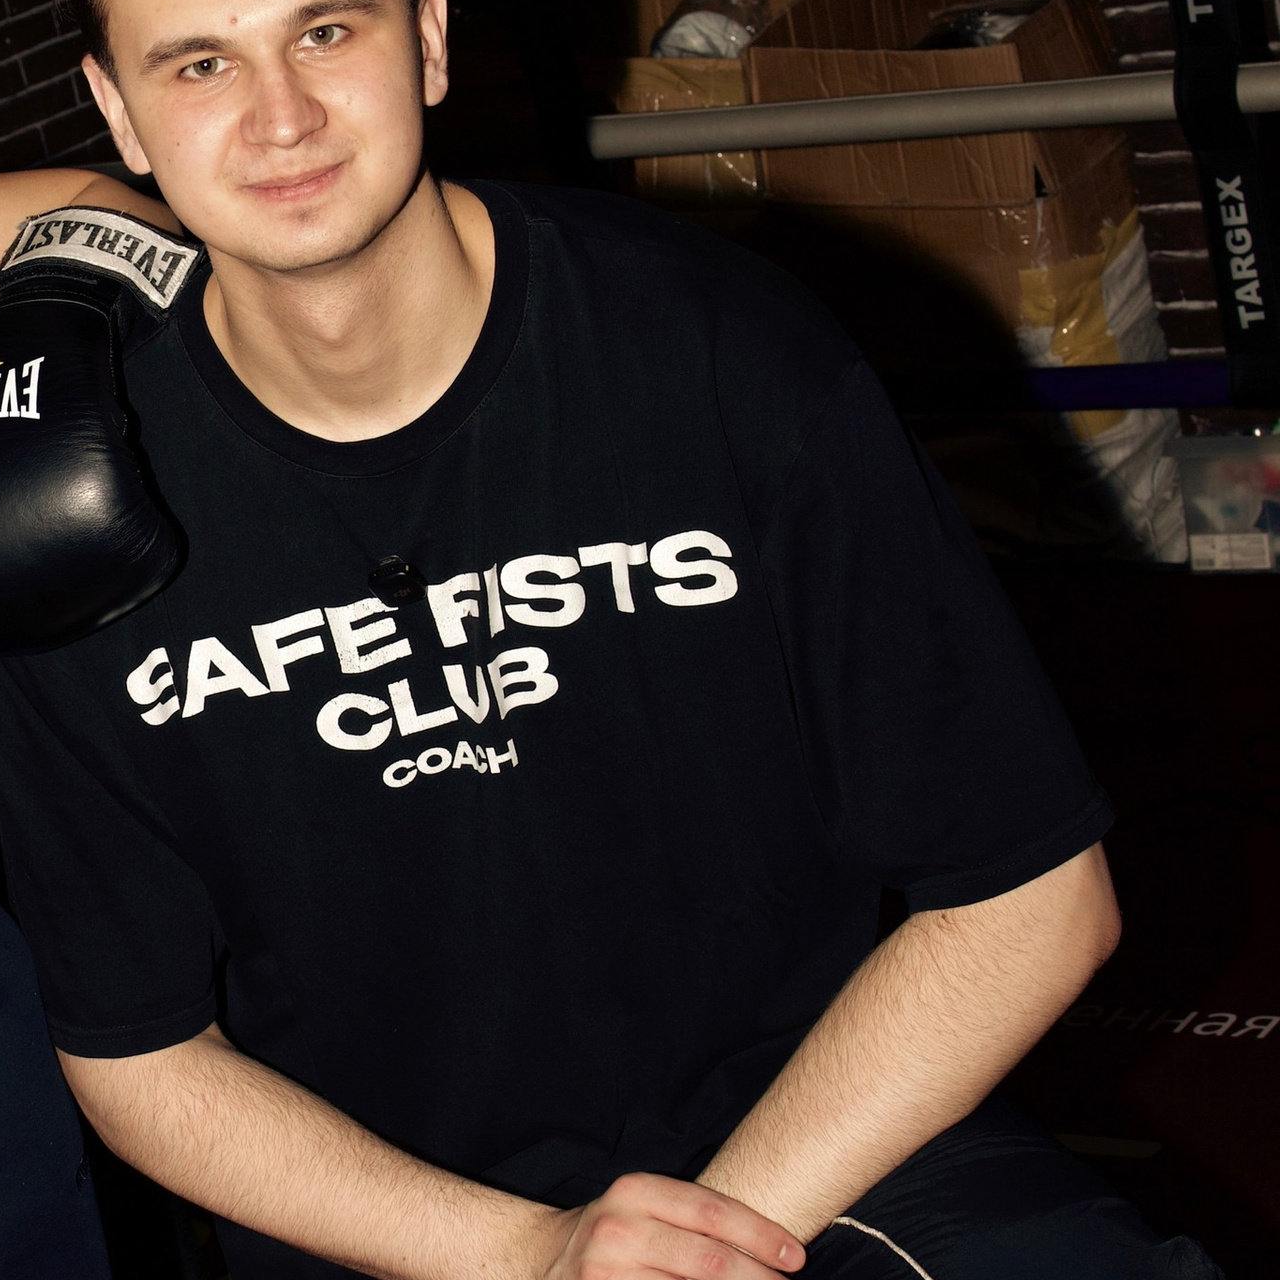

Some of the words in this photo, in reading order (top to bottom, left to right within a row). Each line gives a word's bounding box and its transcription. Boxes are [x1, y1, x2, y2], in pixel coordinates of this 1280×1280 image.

[20, 219, 187, 298] EVERLAST
[1221, 175, 1253, 330] TARGEX
[126, 596, 412, 726] SAFE
[427, 530, 739, 649] FISTS
[316, 647, 558, 751] CLUB
[382, 738, 520, 788] COACH
